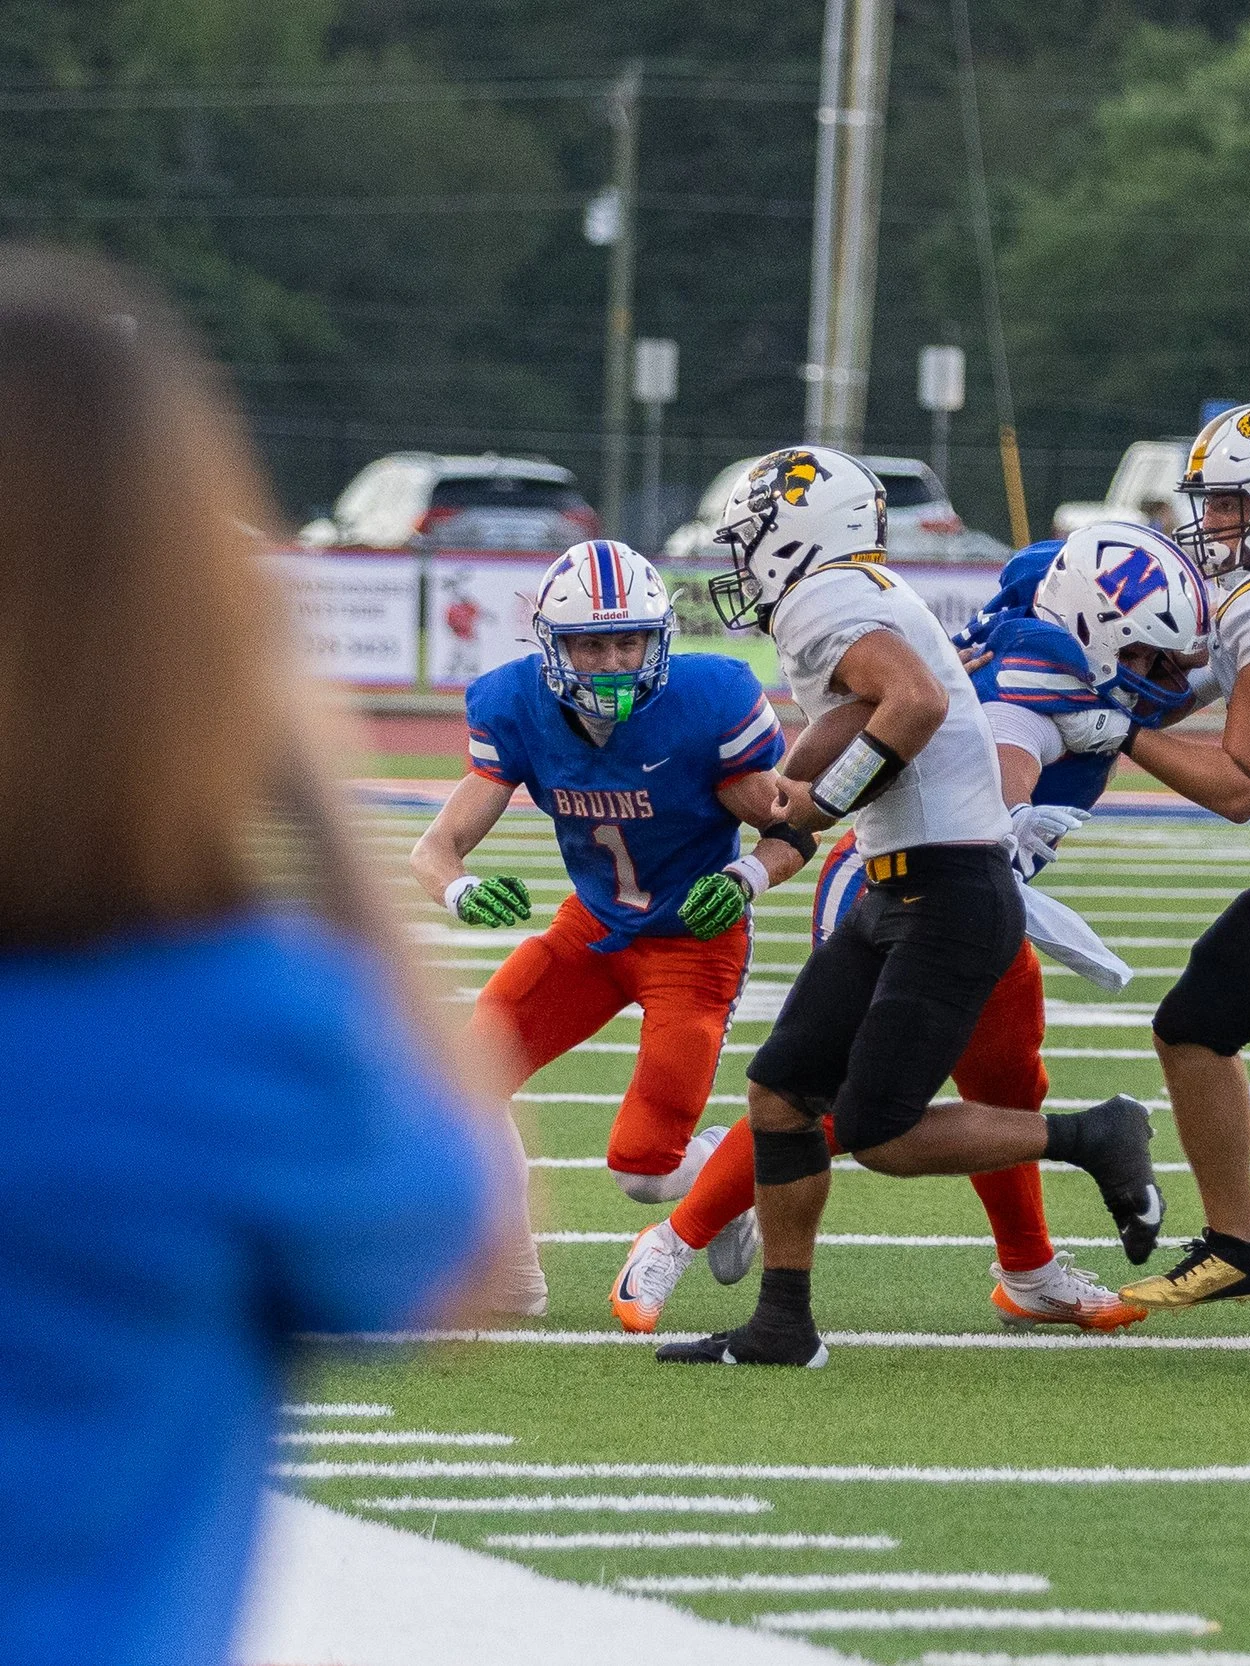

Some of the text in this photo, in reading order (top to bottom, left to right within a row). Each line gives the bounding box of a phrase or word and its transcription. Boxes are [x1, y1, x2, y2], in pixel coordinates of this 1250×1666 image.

[1094, 546, 1168, 616] N
[592, 610, 629, 621] Riddell
[552, 787, 655, 819] BRUINS
[592, 822, 653, 912] 1
